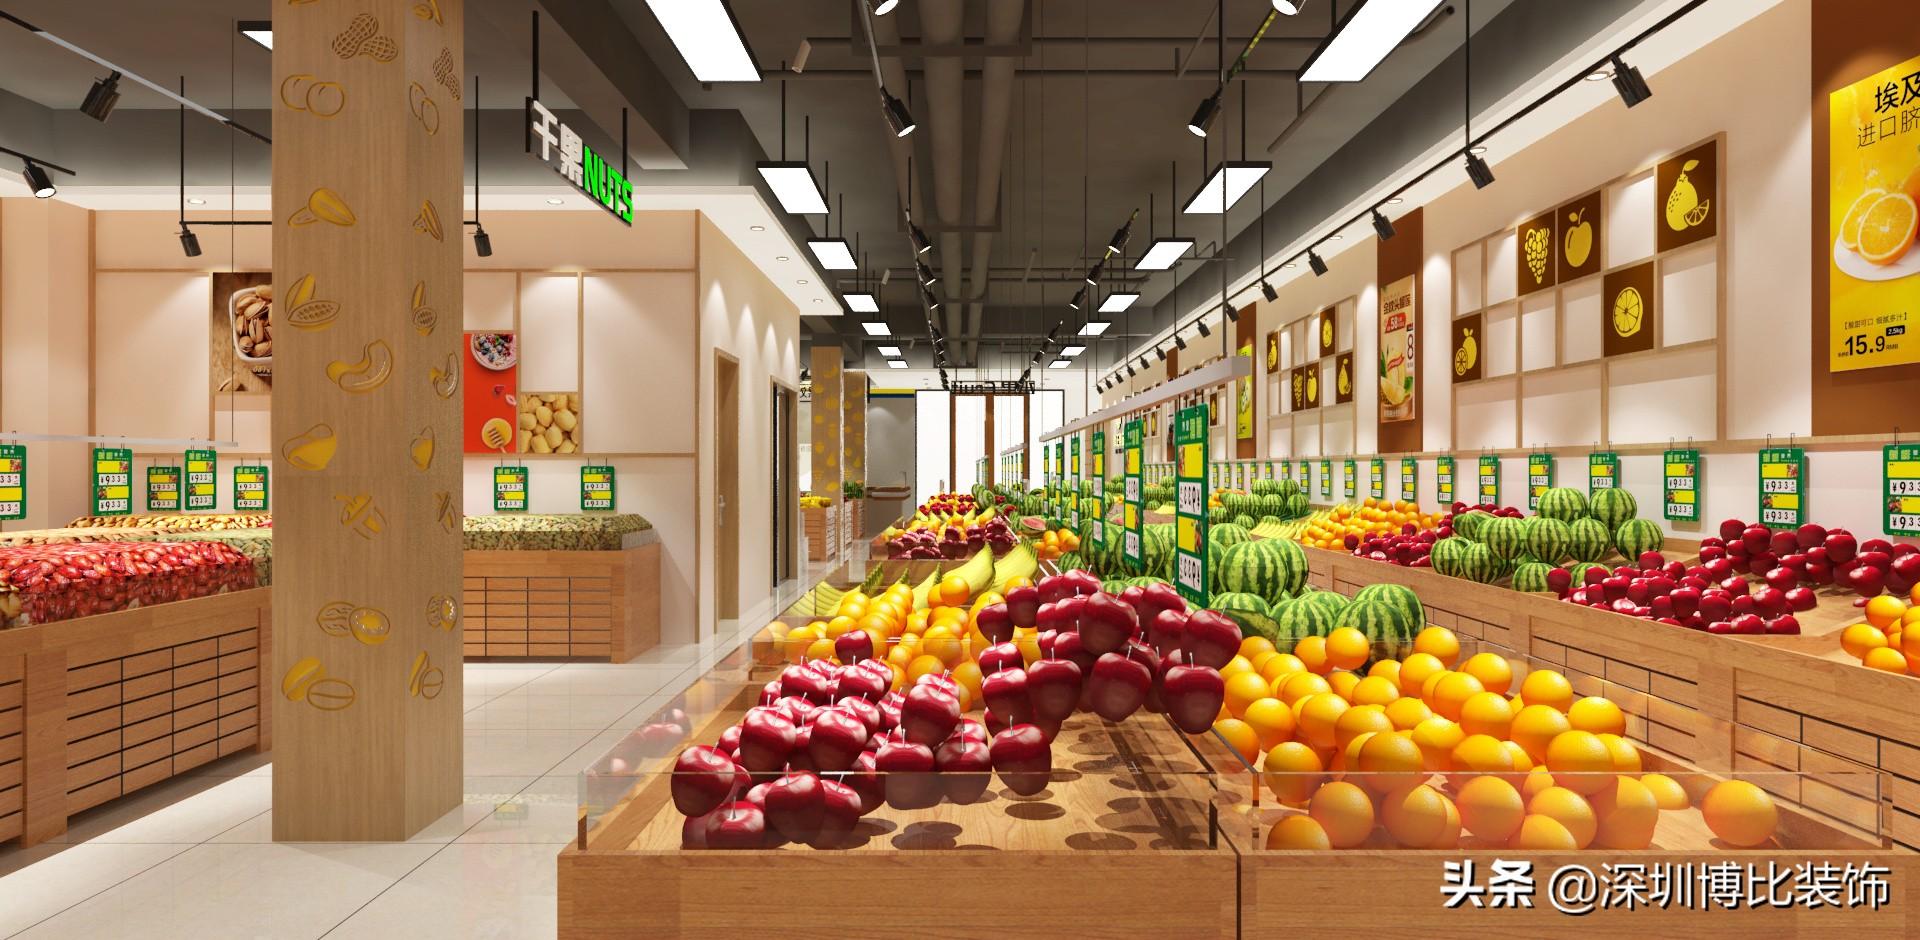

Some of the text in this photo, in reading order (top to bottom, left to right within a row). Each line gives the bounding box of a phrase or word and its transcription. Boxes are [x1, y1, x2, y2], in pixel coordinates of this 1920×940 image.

[1874, 71, 1920, 113] 埃及
[533, 100, 633, 225] 干果 NUTS
[1845, 334, 1885, 356] 15.9
